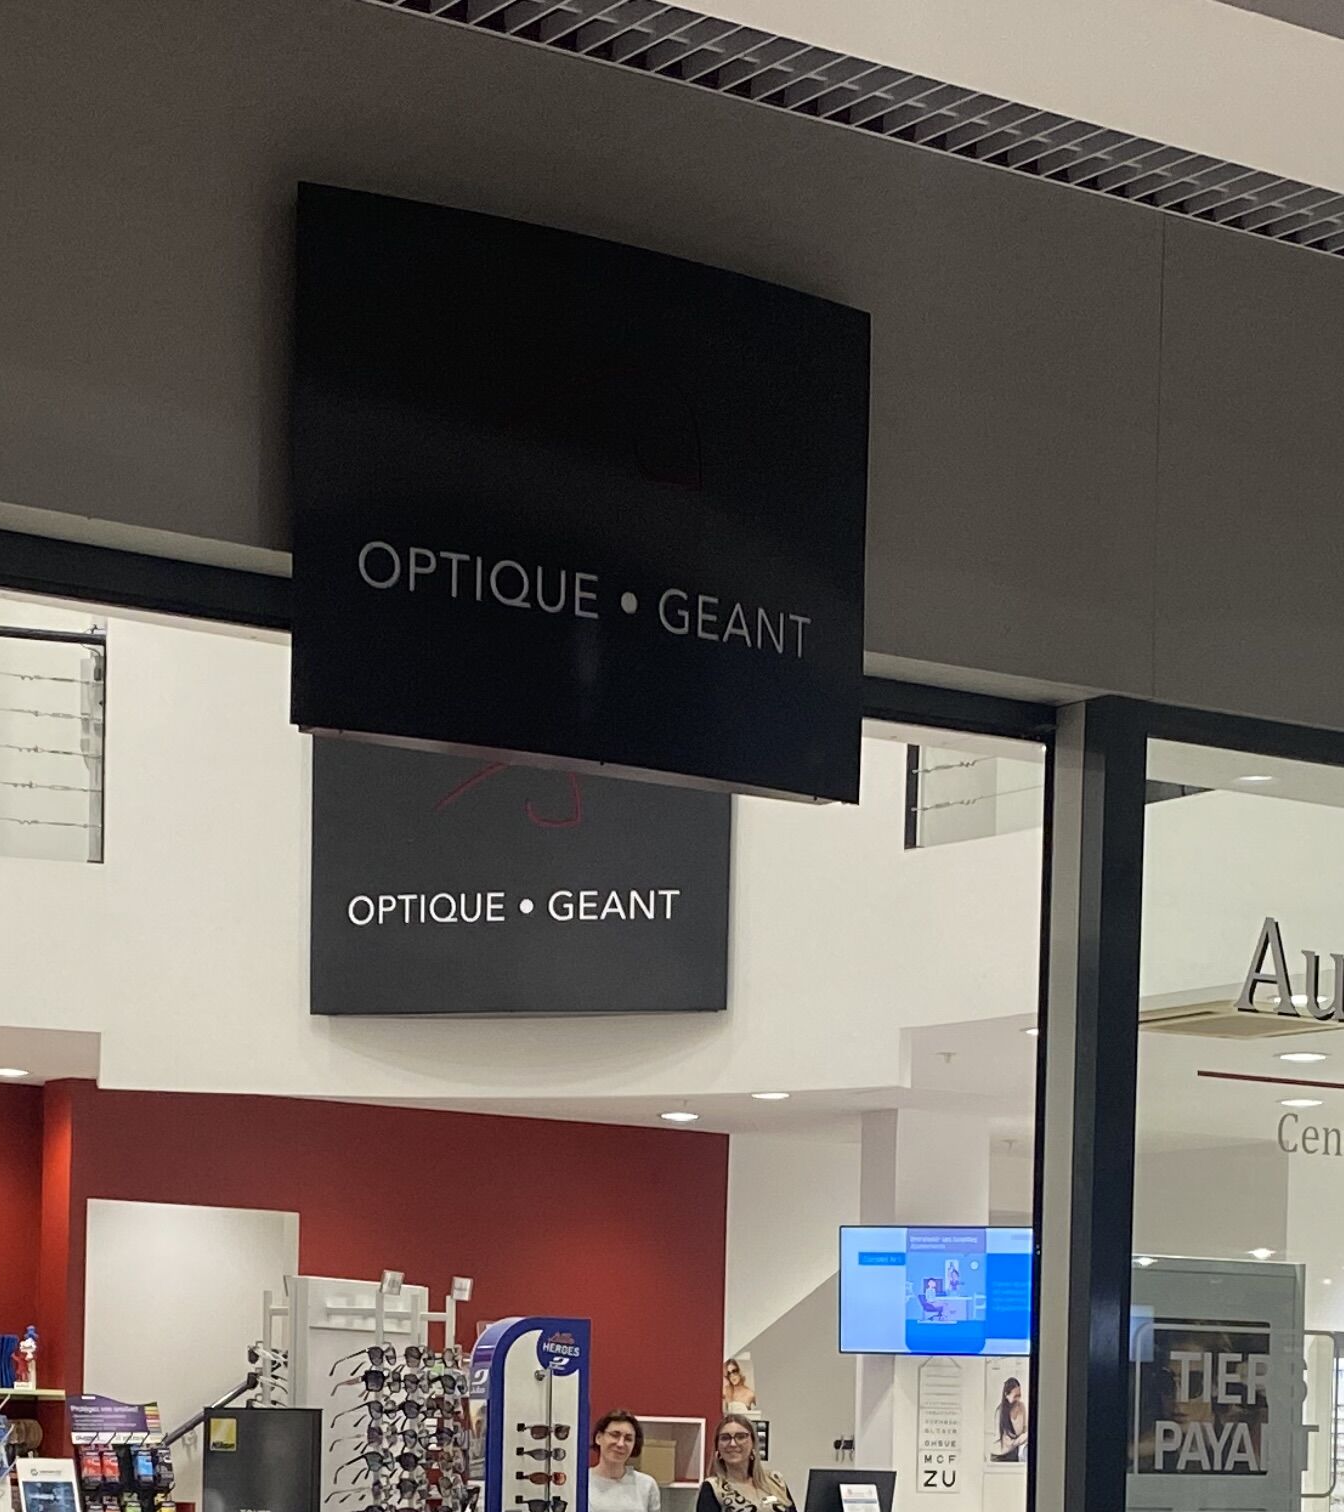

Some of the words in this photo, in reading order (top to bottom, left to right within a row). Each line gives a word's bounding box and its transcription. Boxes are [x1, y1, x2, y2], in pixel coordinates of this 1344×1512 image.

[357, 540, 600, 621] OPTIQUE
[657, 588, 812, 659] GEANT
[347, 891, 506, 926] OPTIQUE
[547, 889, 681, 922] GEANT
[542, 1342, 580, 1357] HEROES
